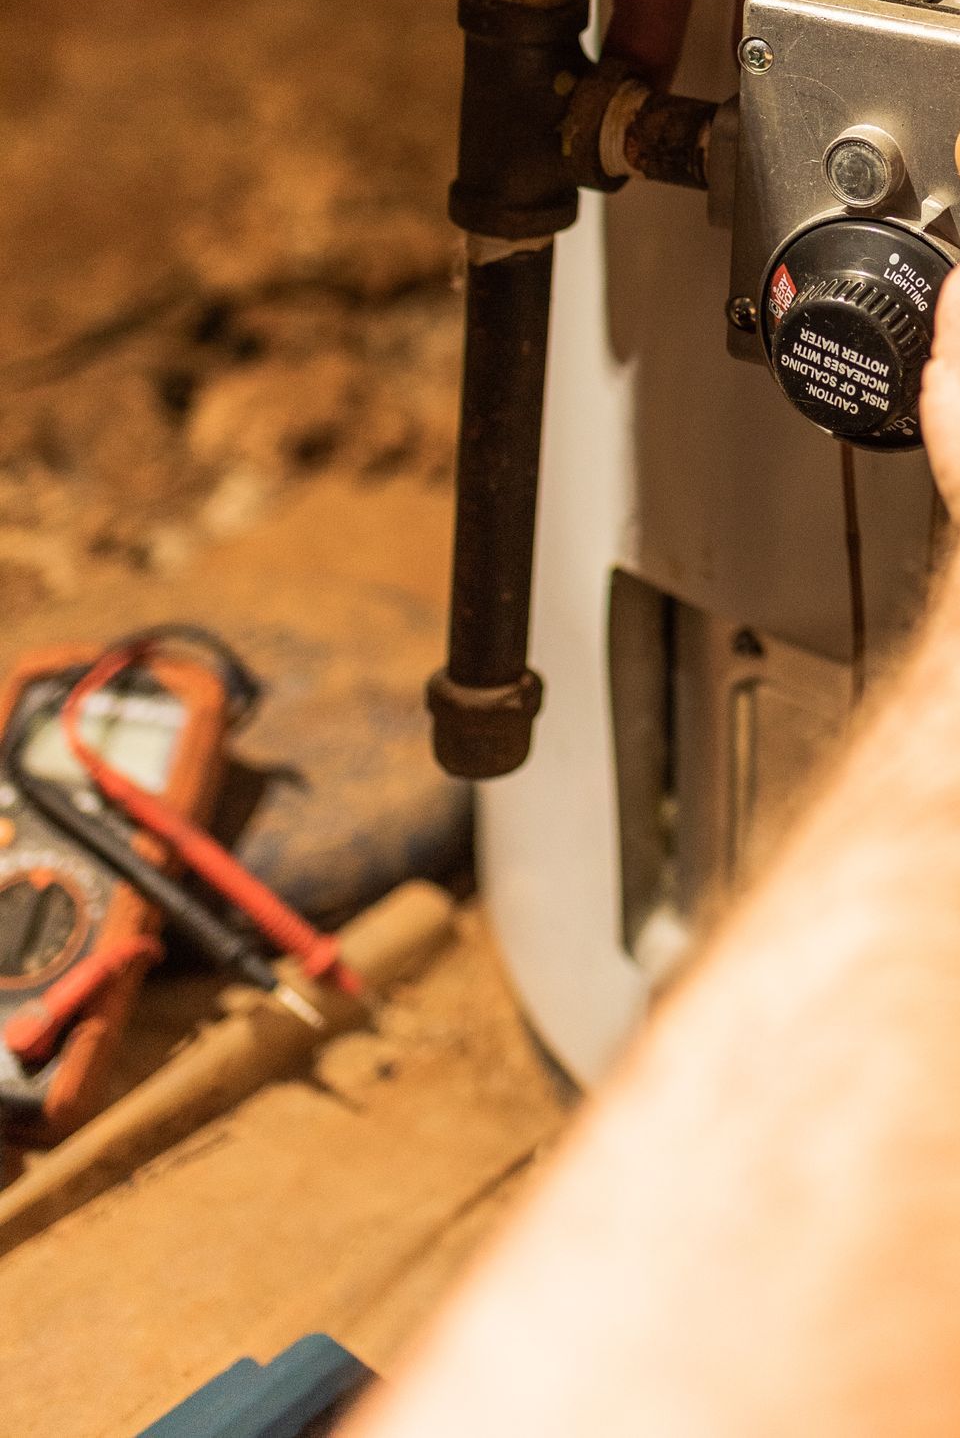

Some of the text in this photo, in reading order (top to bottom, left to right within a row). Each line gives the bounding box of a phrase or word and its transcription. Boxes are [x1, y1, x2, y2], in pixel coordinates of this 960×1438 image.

[773, 273, 789, 305] VERY
[883, 267, 929, 312] LIGHTING
[899, 263, 932, 293] PILOT
[781, 285, 795, 311] HOT
[792, 342, 890, 392] INCREASES WITH
[800, 328, 890, 377] HOTTER WATER
[780, 354, 890, 412] RISK OF SCALDING
[805, 382, 860, 415] CAUTION:
